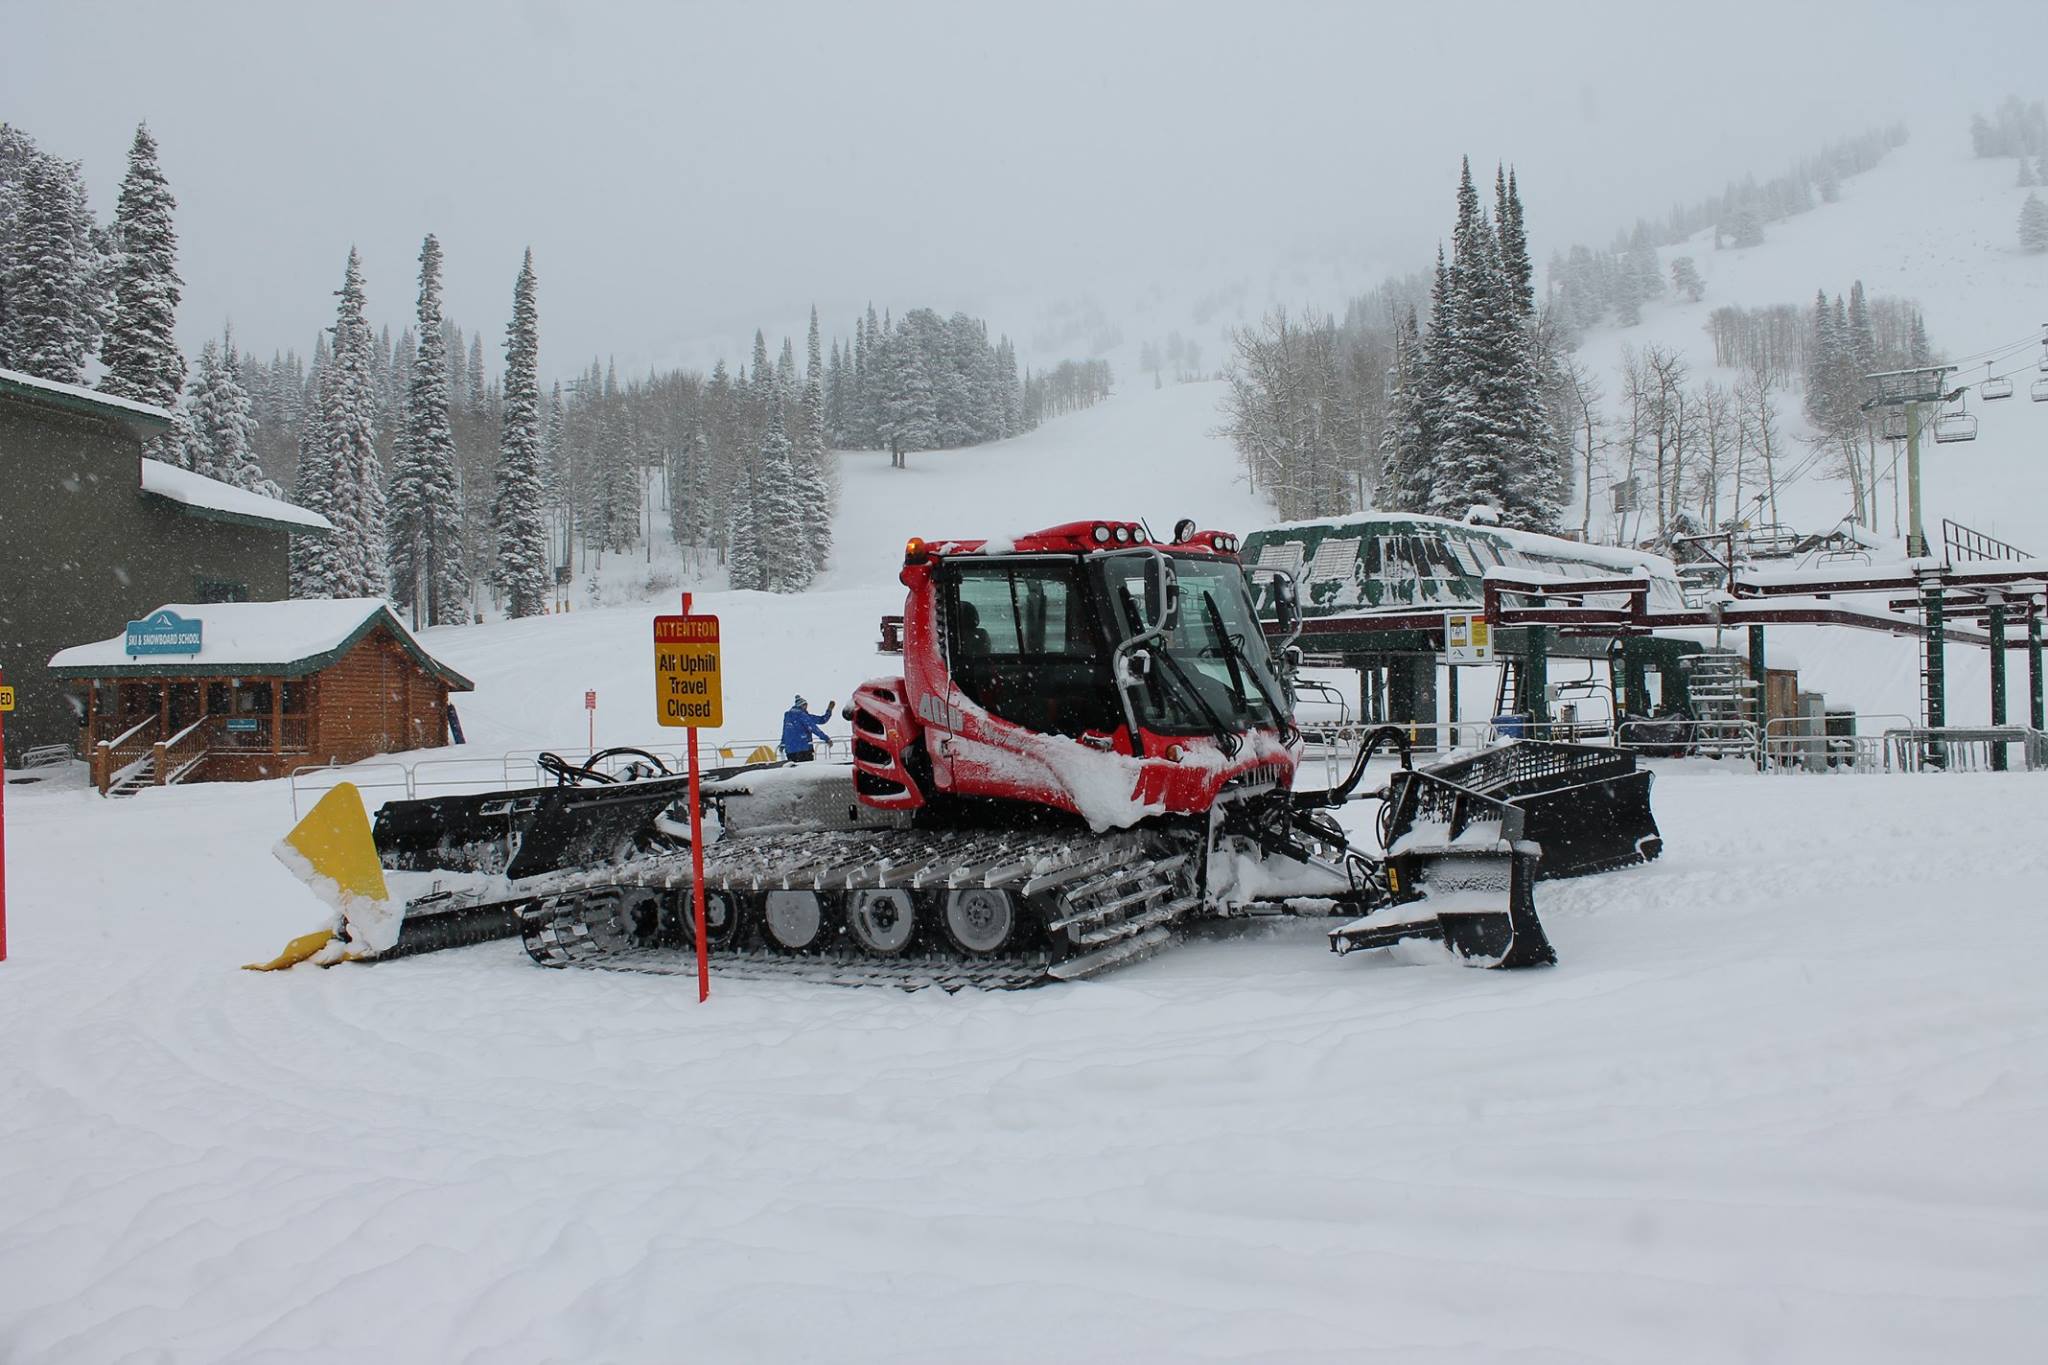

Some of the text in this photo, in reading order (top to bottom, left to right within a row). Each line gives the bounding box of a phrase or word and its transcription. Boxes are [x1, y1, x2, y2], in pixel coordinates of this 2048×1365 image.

[655, 621, 717, 637] ATTENTION
[128, 632, 200, 646] SKI & SNOWBOARD SCHOOL
[659, 654, 716, 676] All Uphill
[669, 676, 707, 695] Travel
[667, 698, 711, 718] Closed
